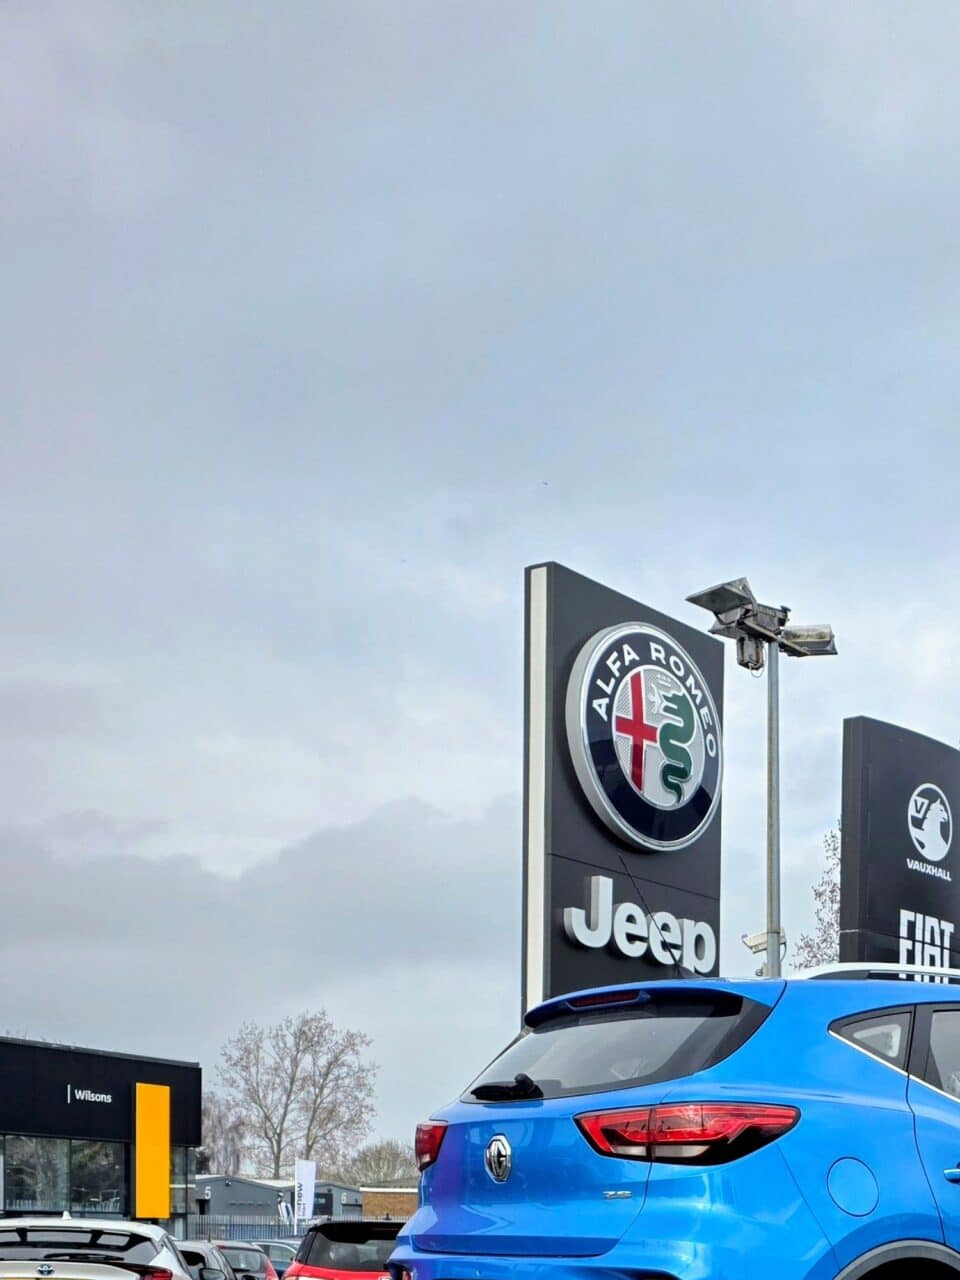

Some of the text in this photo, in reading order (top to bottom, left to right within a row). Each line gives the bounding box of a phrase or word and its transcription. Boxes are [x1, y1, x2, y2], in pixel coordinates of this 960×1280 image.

[592, 641, 716, 758] ALFA ROMEO
[906, 858, 953, 882] VAUXHALL
[564, 875, 716, 974] Jeep
[899, 908, 954, 985] FIAT
[74, 1089, 113, 1104] Wilsons
[204, 1186, 212, 1200] 5
